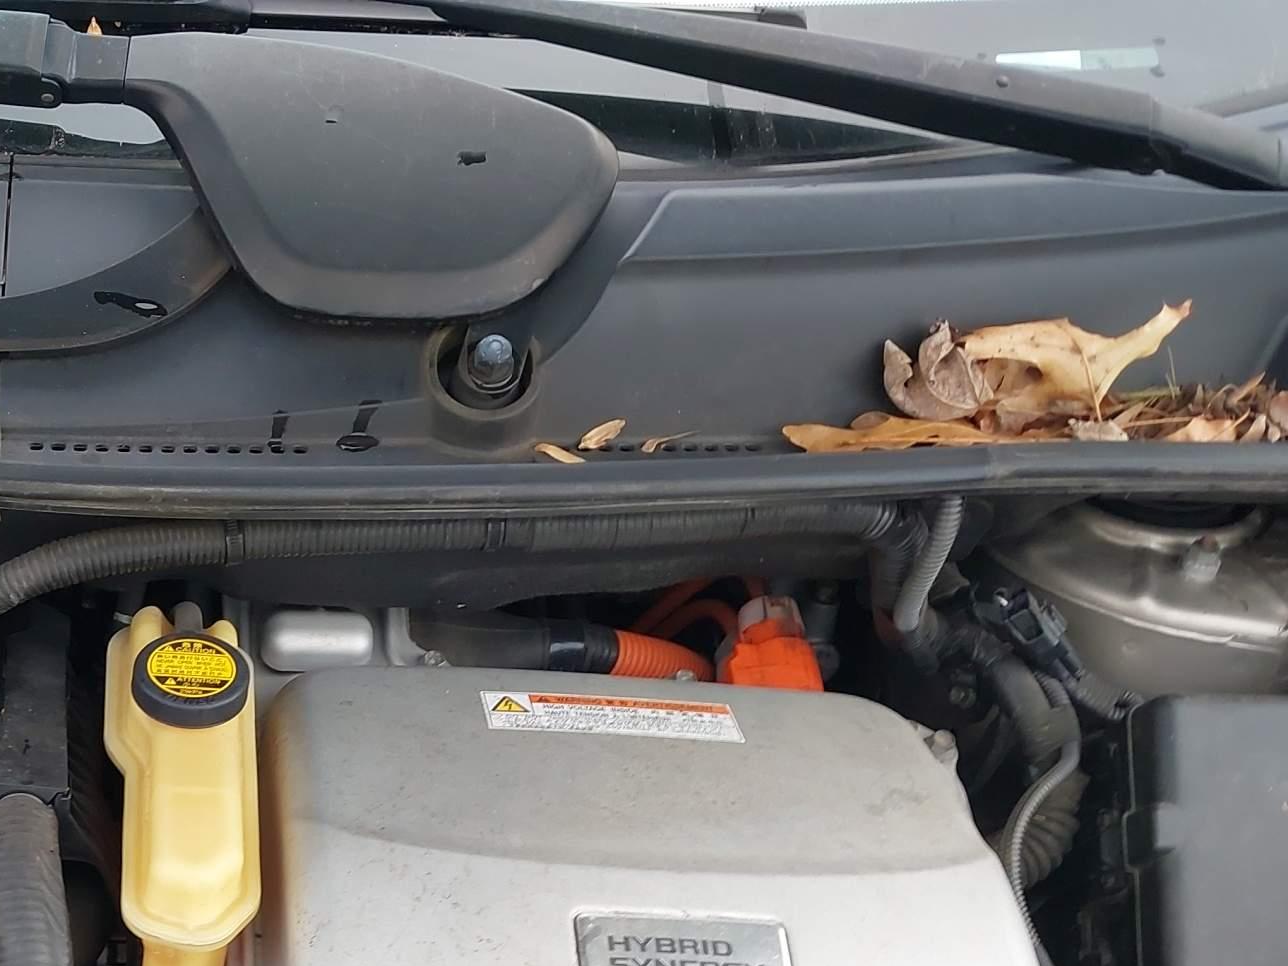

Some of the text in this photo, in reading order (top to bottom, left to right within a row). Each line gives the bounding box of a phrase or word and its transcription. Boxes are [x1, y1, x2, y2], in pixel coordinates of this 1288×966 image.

[175, 646, 216, 654] CAUTION
[176, 677, 221, 685] ATTENTION
[607, 935, 733, 957] HYBRID
